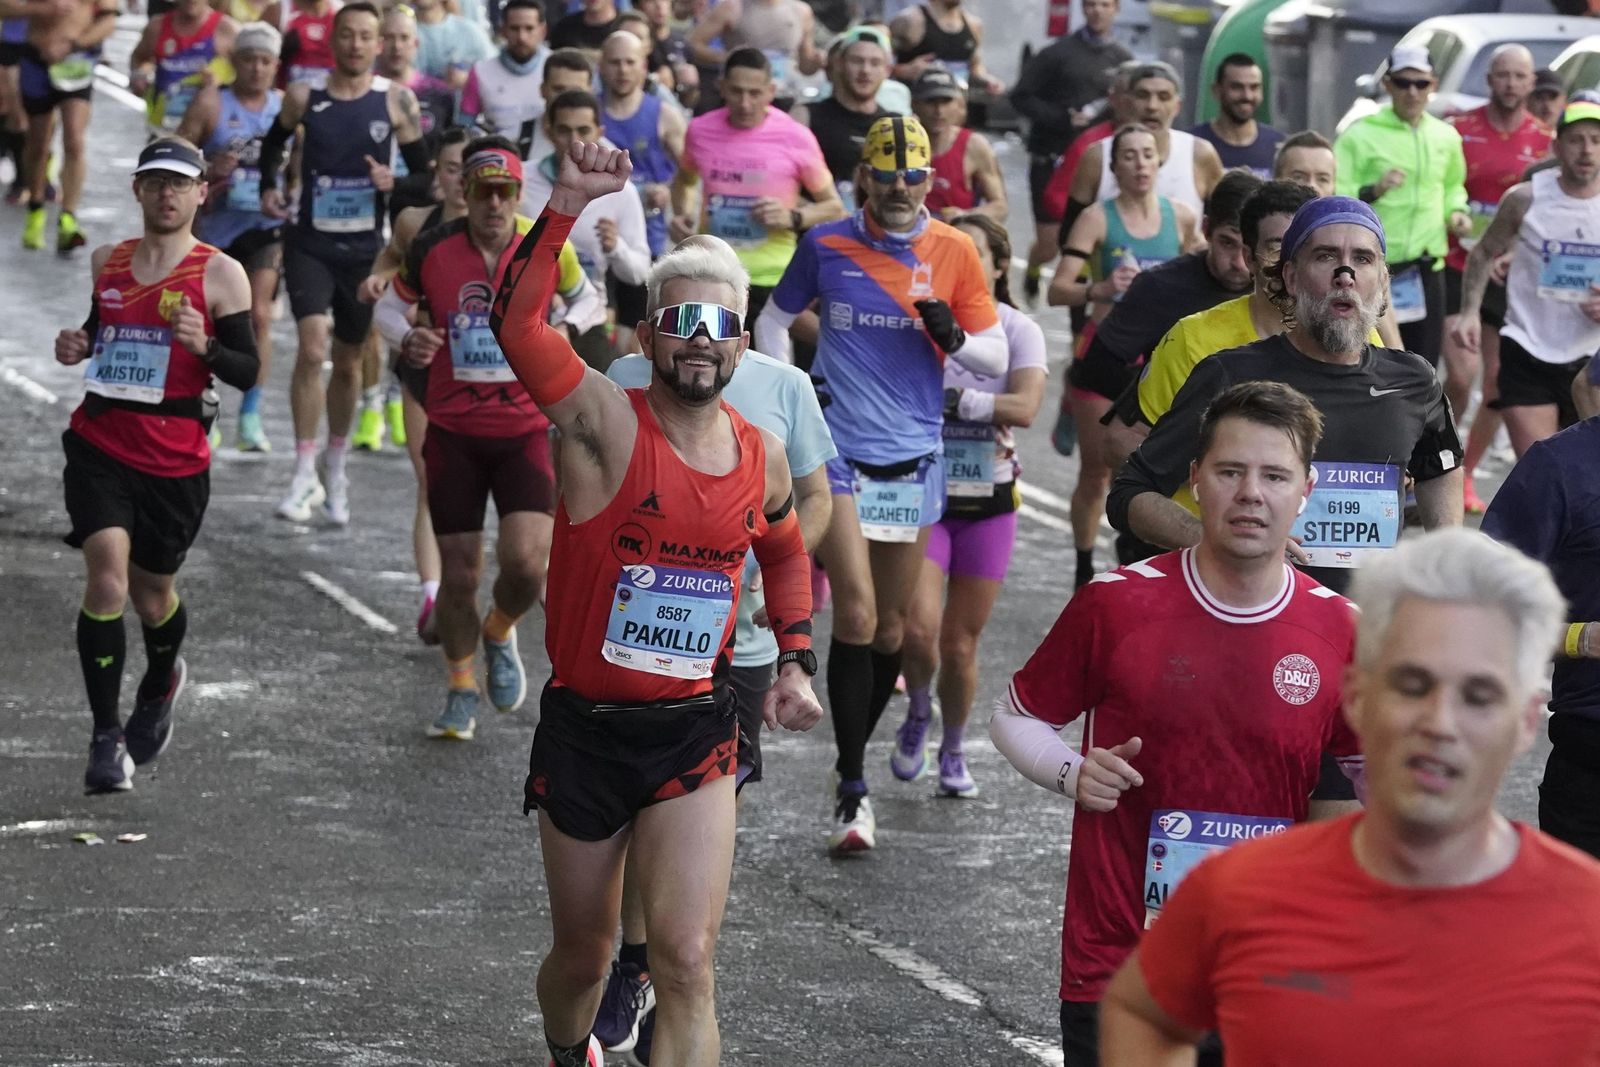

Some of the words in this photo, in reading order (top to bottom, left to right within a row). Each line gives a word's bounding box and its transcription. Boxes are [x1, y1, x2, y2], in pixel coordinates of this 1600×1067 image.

[117, 327, 163, 342] ZURICH
[96, 365, 156, 383] KRISTOF
[1326, 469, 1385, 485] ZURICH
[1327, 500, 1361, 515] 6199
[1303, 521, 1381, 543] STEPPA
[662, 574, 721, 593] ZURICH
[656, 605, 692, 623] 8587
[622, 620, 711, 654] PAKILLO
[1283, 669, 1311, 687] DBU
[1200, 820, 1277, 840] ZURICH
